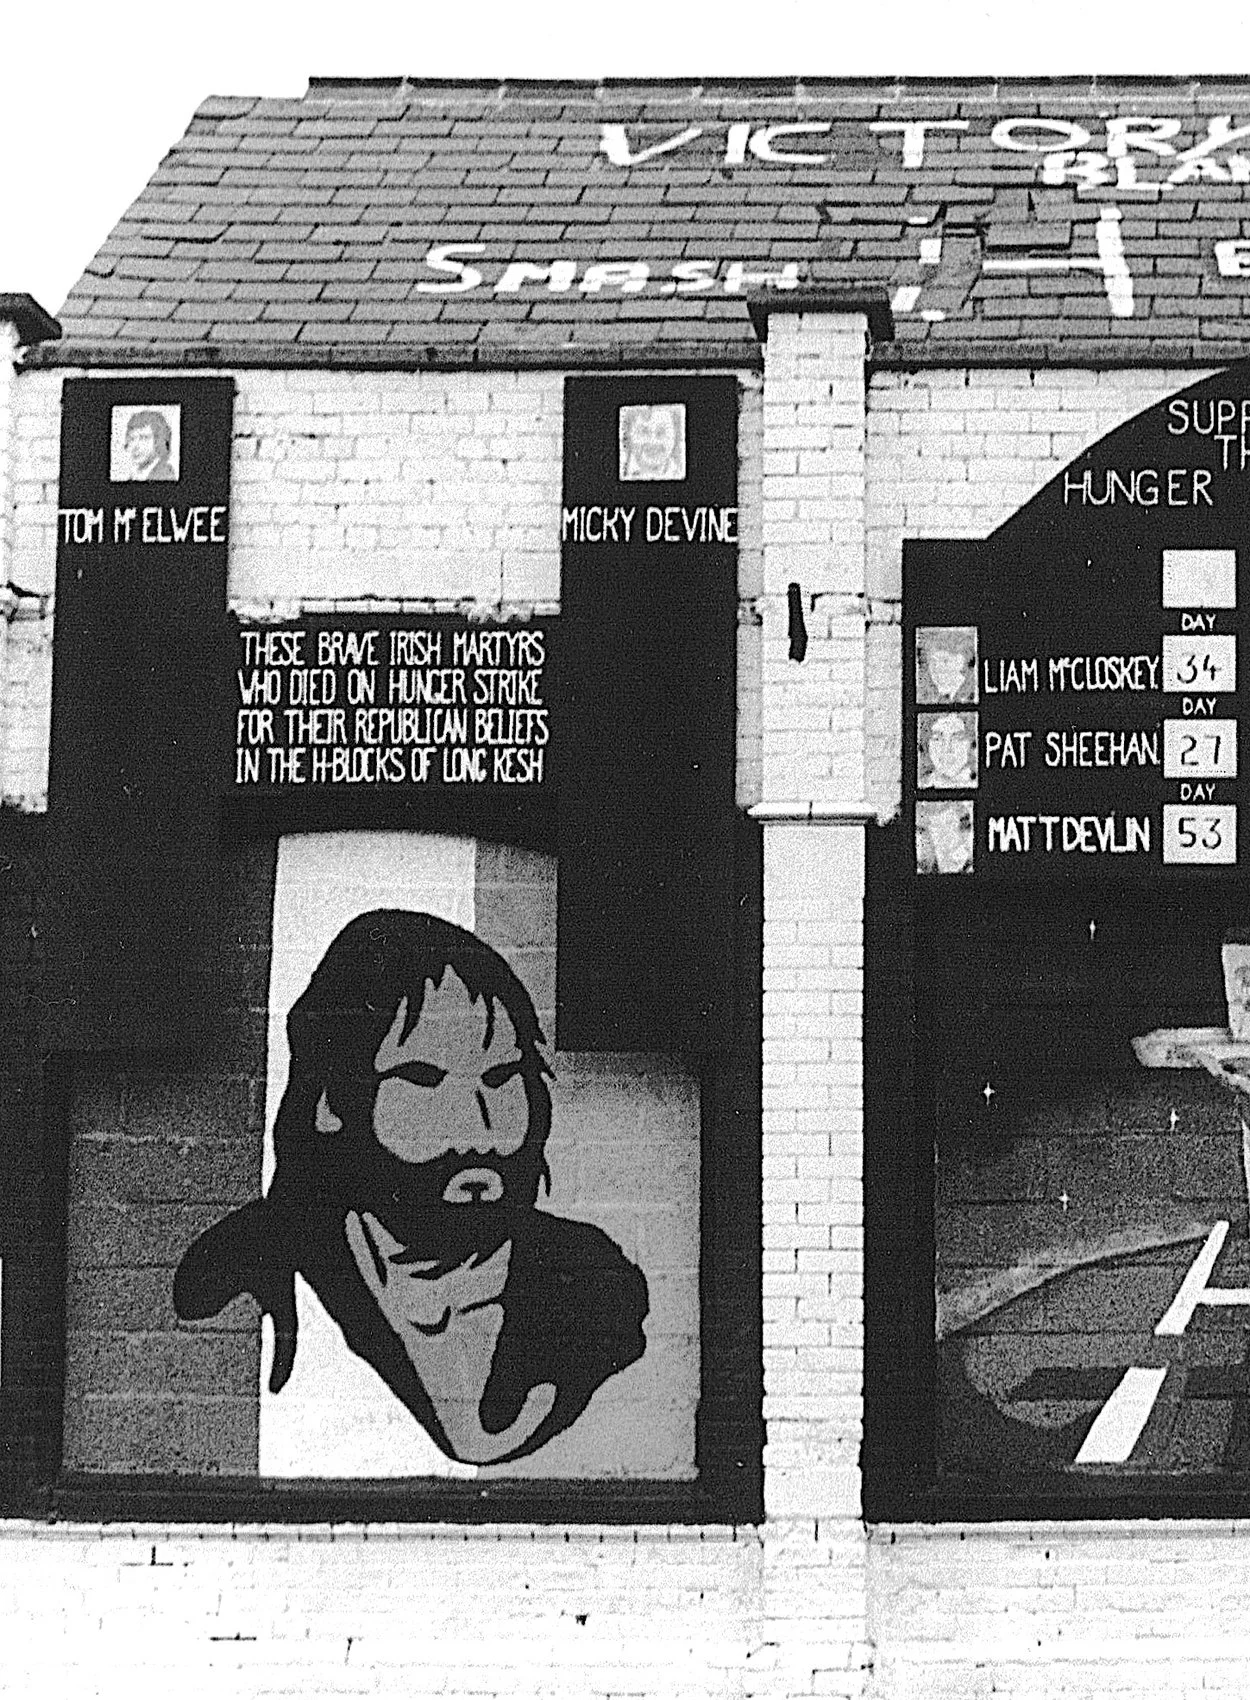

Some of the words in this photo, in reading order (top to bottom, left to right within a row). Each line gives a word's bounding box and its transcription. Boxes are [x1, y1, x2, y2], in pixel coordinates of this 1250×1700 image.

[415, 243, 801, 294] SMASH
[1063, 469, 1214, 506] HUNGER
[58, 507, 105, 544] TOM
[142, 506, 227, 544] ELWEE
[562, 506, 636, 543] MICKY
[646, 506, 738, 543] DEVINE
[1180, 612, 1217, 632] DAY
[240, 630, 306, 666] THESE
[317, 630, 379, 666] BRAVE
[389, 631, 442, 667] IRISH
[452, 630, 546, 667] MARTYRS
[237, 668, 281, 704] WHO
[288, 669, 336, 706] DIED
[347, 669, 376, 705] ON
[388, 668, 465, 705] HUNGER
[472, 668, 543, 705] STRIKE
[983, 657, 1038, 694] LIAM
[1176, 654, 1222, 684] 34
[1182, 698, 1218, 716] DAY
[236, 708, 274, 745] FOR
[283, 709, 347, 745] THEIR
[355, 708, 467, 745] REPUBLICAN
[235, 748, 260, 783] IN
[266, 747, 306, 783] THE
[312, 747, 406, 783] H-BLOCKS
[410, 747, 437, 783] OF
[442, 747, 487, 783] LONG
[493, 747, 544, 783] KESH
[985, 731, 1033, 768] PAT
[1180, 734, 1221, 766] 27
[1179, 783, 1217, 801] DAY
[1178, 817, 1223, 850] 53
